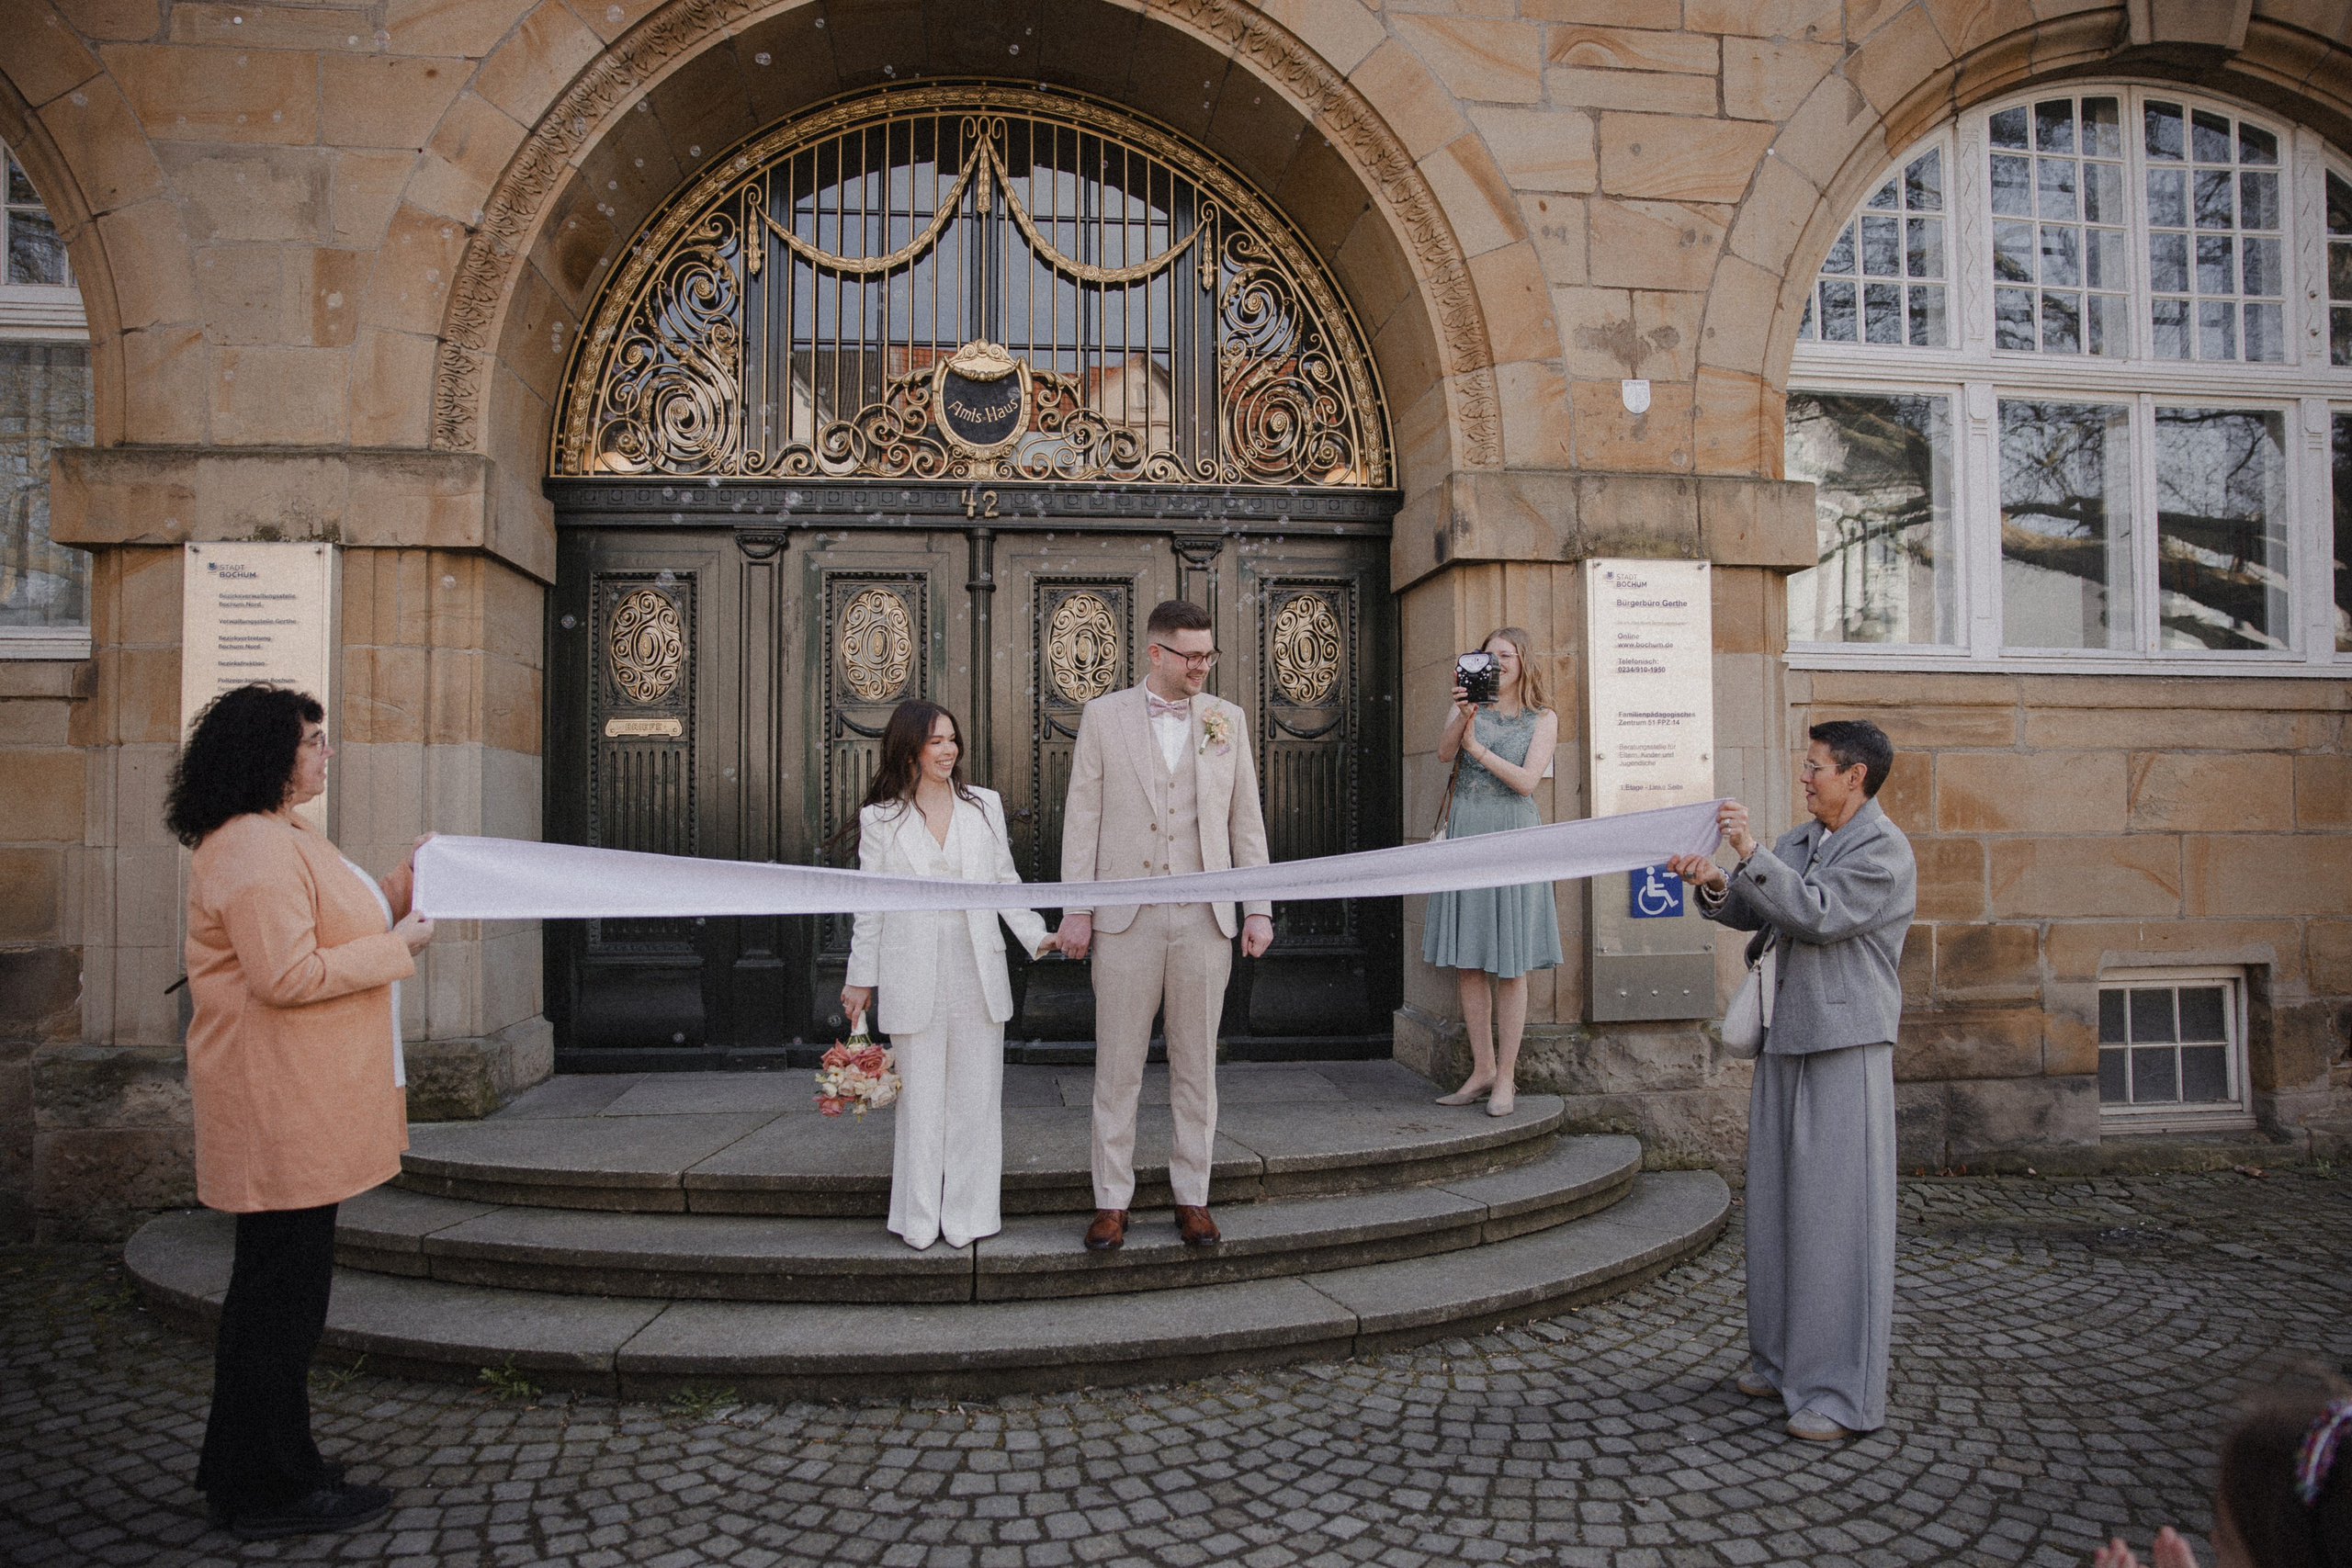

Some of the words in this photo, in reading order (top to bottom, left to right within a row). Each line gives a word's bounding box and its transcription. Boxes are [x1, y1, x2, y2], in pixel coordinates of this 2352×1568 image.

[961, 490, 1000, 517] 42
[1616, 599, 1660, 608] Bürgerbüro
[626, 723, 662, 731] BRIEFE
